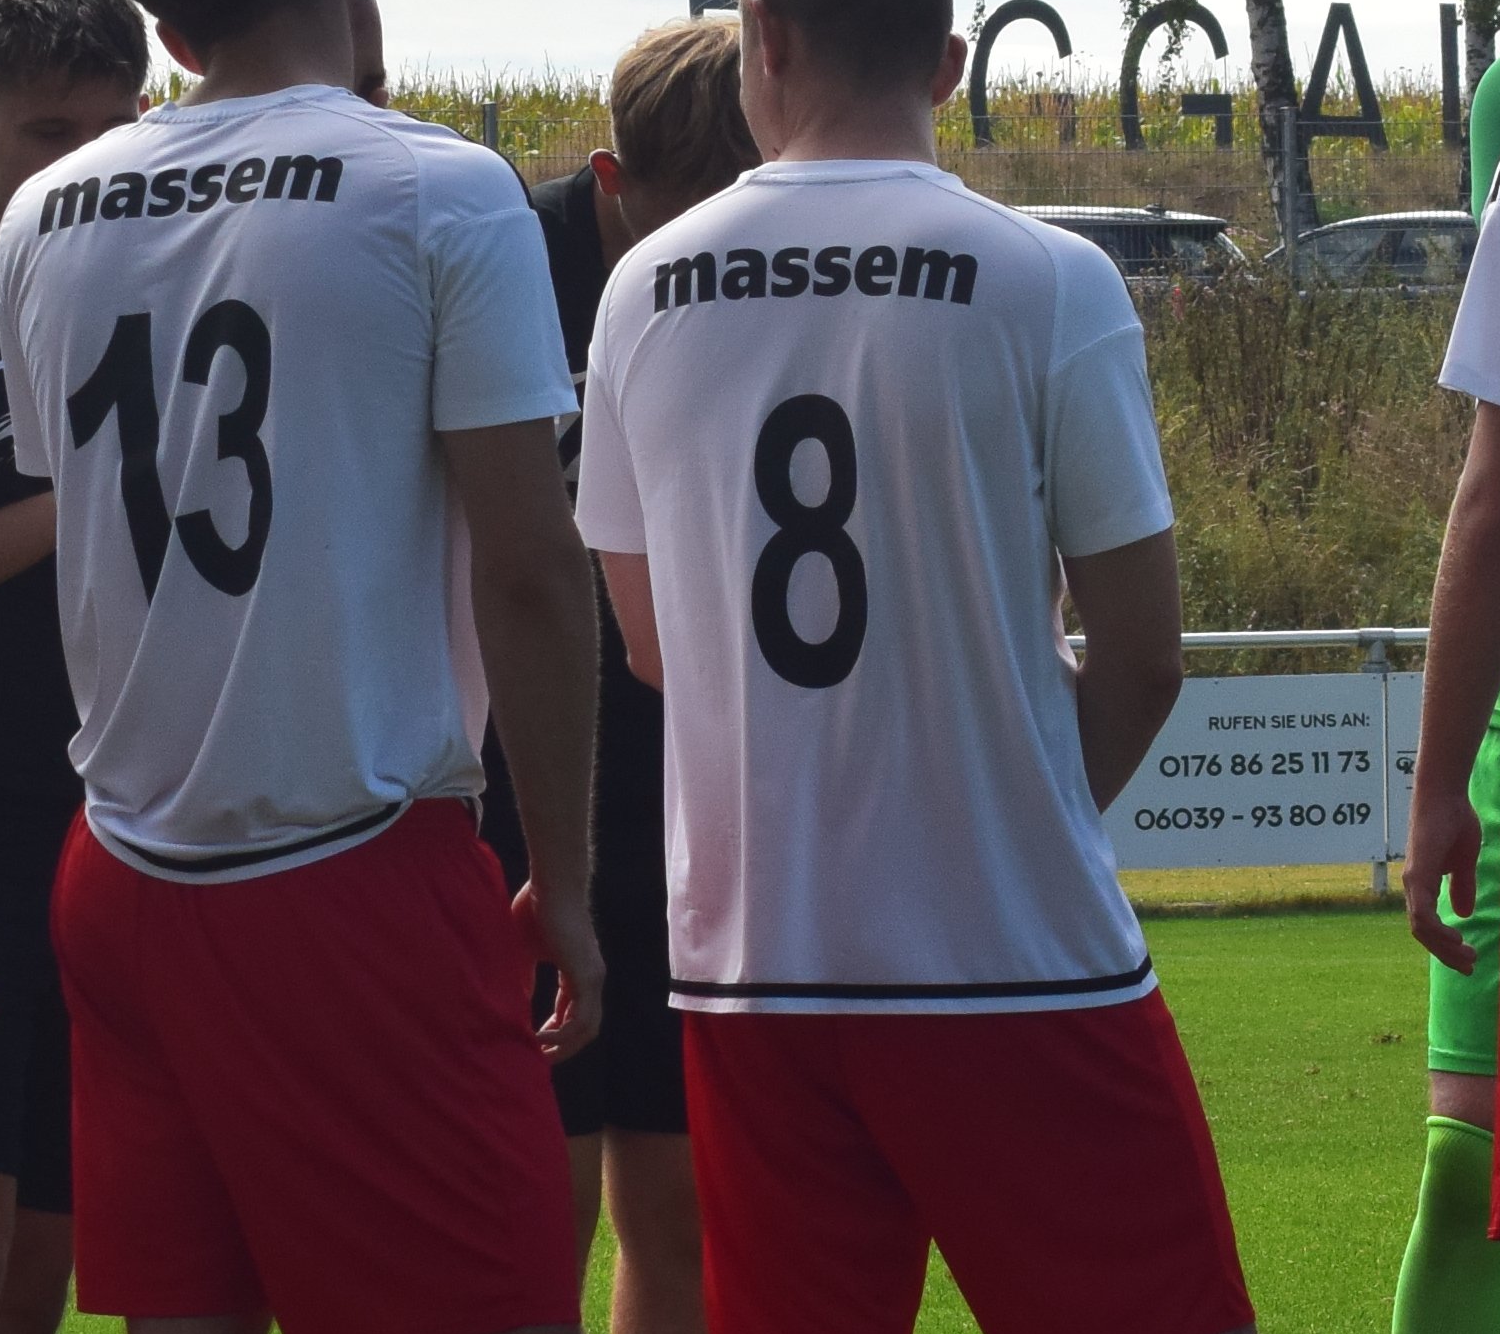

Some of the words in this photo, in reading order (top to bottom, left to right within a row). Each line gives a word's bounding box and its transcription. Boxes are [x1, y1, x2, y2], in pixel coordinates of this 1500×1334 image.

[38, 154, 344, 236] massem
[652, 244, 978, 314] massem
[66, 299, 273, 607] 13
[751, 393, 867, 689] 8
[1209, 716, 1266, 731] RUFEN
[1271, 715, 1296, 729] SIE
[1301, 713, 1337, 728] UNS
[1341, 712, 1370, 727] AN:
[1159, 754, 1222, 778] 0176
[1230, 753, 1263, 776] 86
[1271, 752, 1304, 775] 25
[1311, 751, 1329, 774] 11
[1337, 750, 1371, 773] 73
[1134, 807, 1225, 831] 06039
[1251, 805, 1283, 828] 93
[1289, 804, 1326, 827] 80
[1332, 802, 1372, 826] 619
